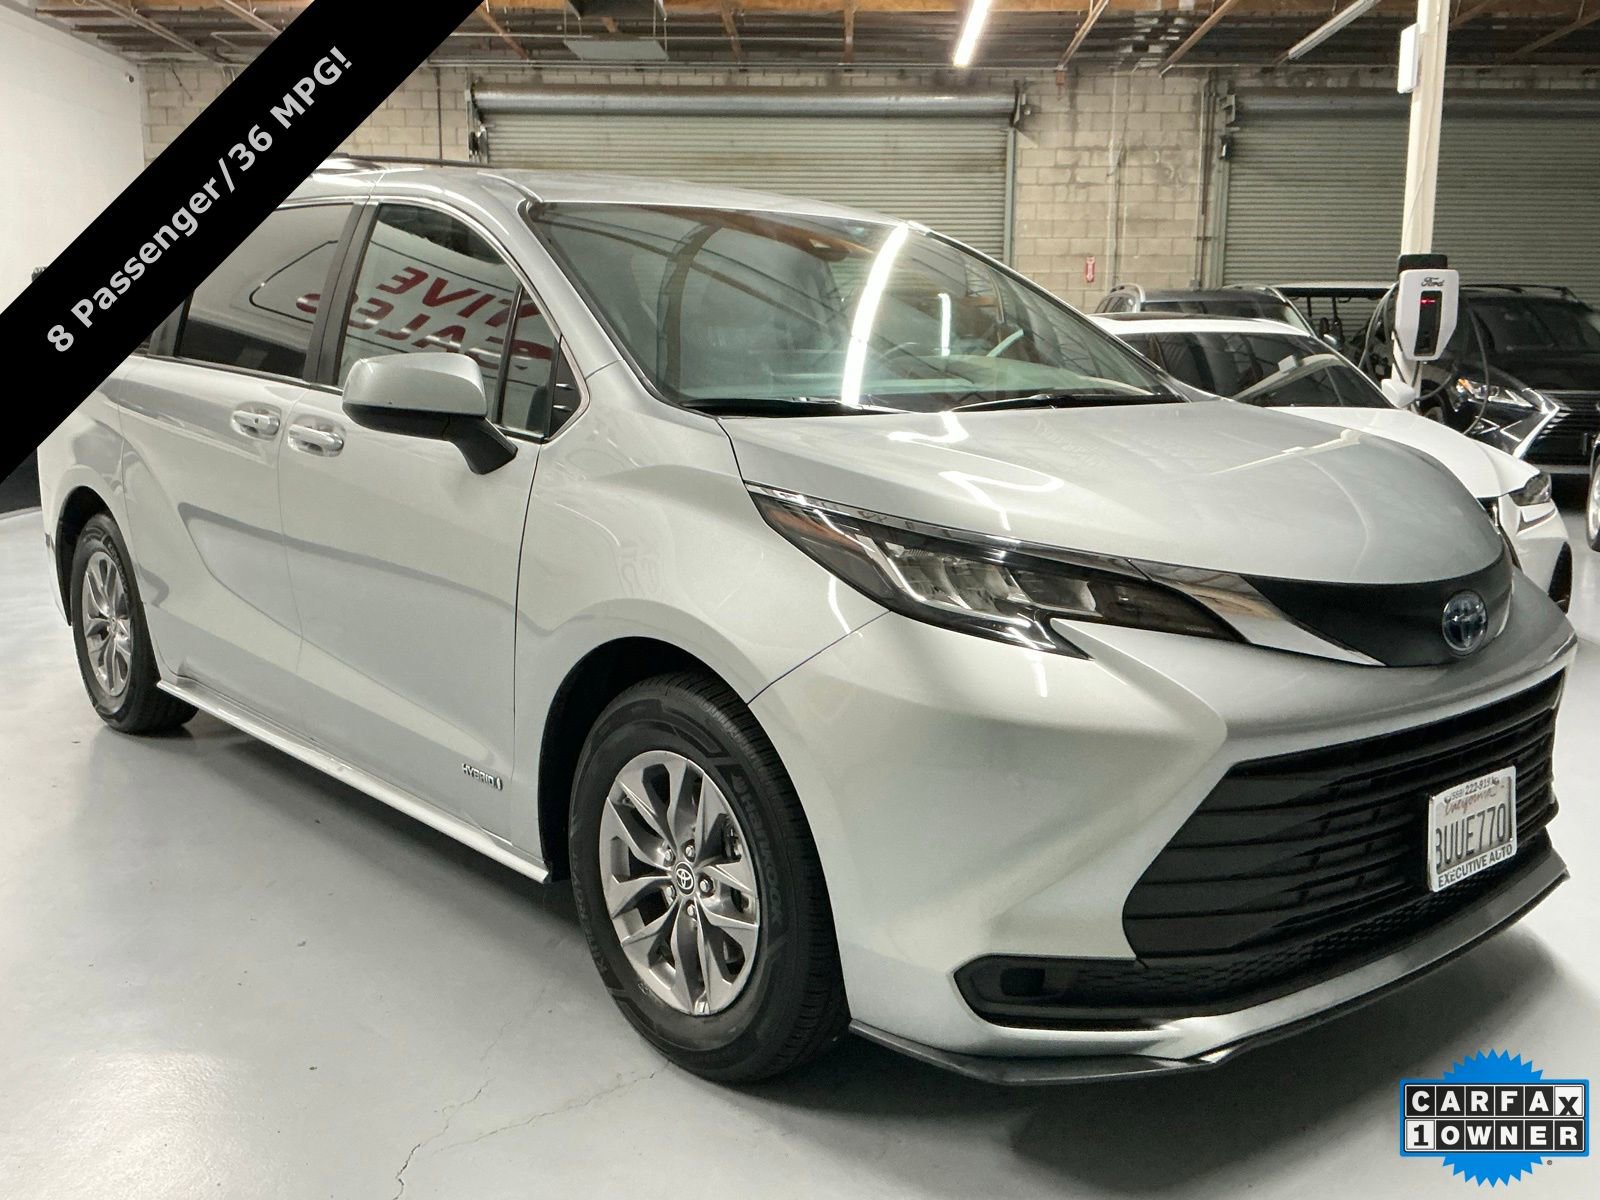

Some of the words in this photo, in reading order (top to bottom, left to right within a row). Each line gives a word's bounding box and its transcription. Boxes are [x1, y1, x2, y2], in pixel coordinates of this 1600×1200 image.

[1421, 276, 1445, 287] Ford
[461, 763, 495, 787] HYBRID
[1438, 855, 1488, 888] EXECUTIVE
[1488, 844, 1512, 863] AUTO
